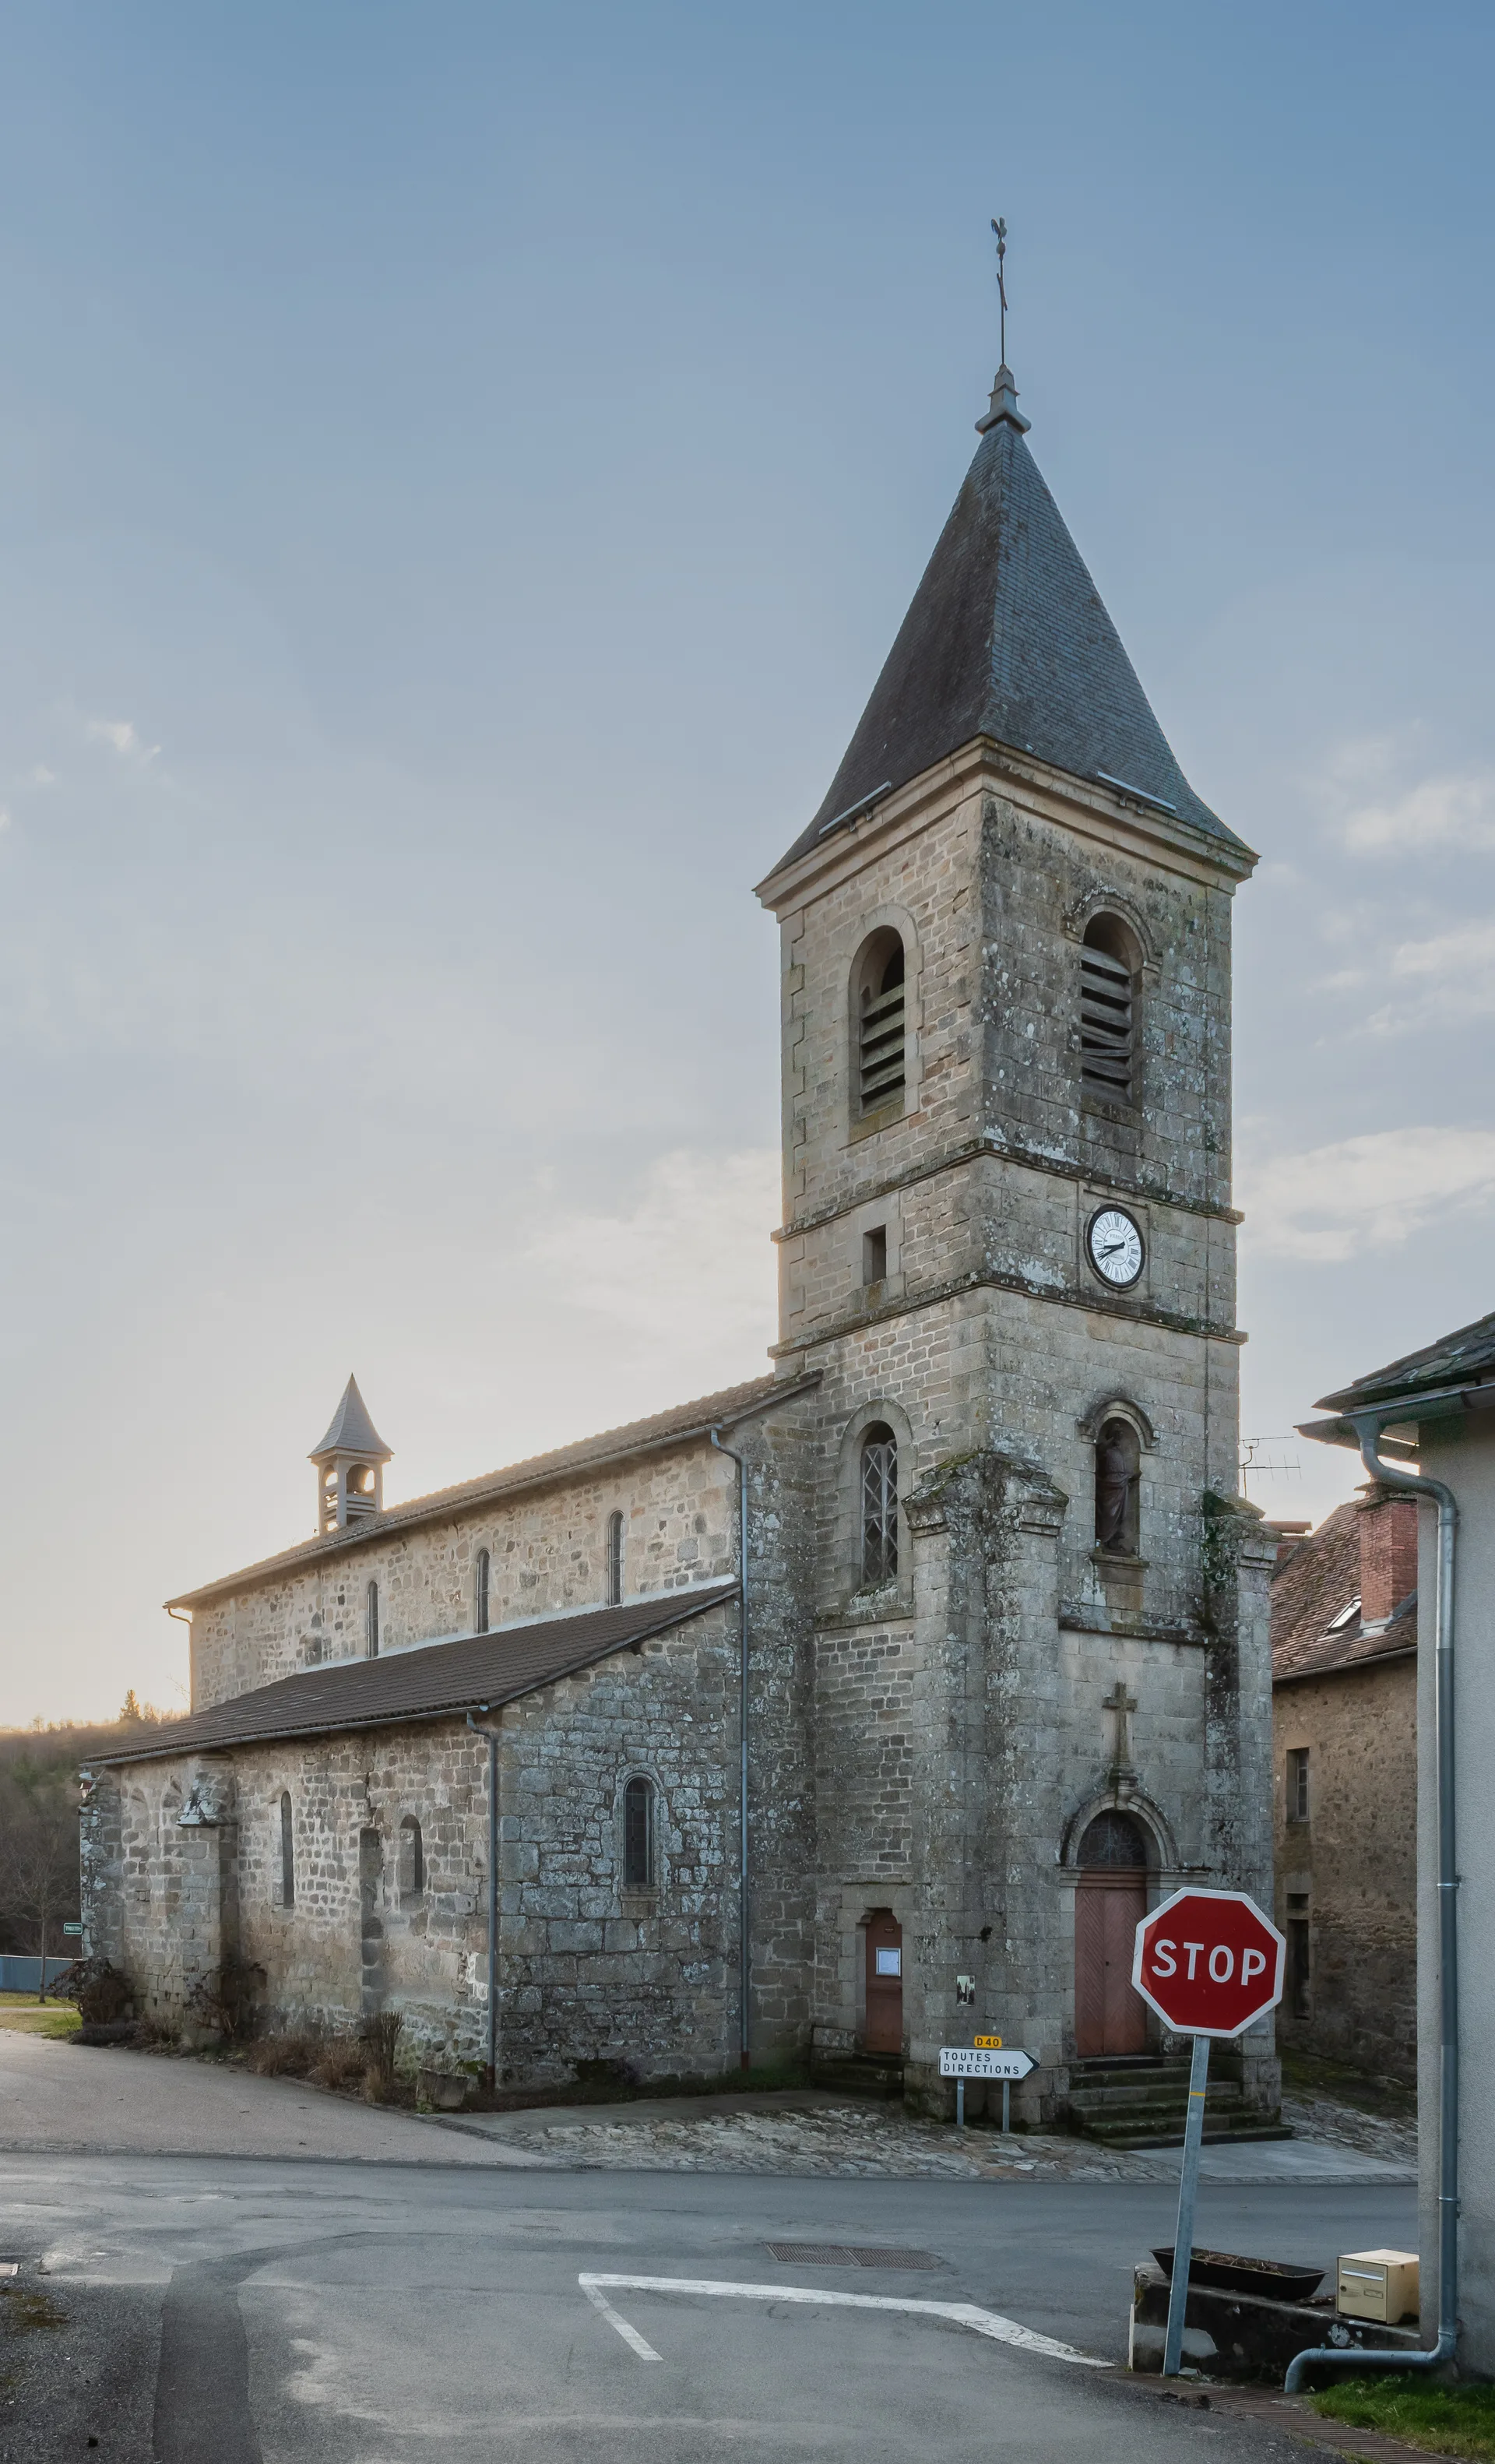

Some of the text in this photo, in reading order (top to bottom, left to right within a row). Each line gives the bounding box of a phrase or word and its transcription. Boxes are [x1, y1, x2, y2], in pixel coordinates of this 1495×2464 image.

[1151, 1939, 1267, 1986] STOP
[944, 2051, 991, 2062] TOUTES
[944, 2064, 1019, 2075] DIRECTIONS
